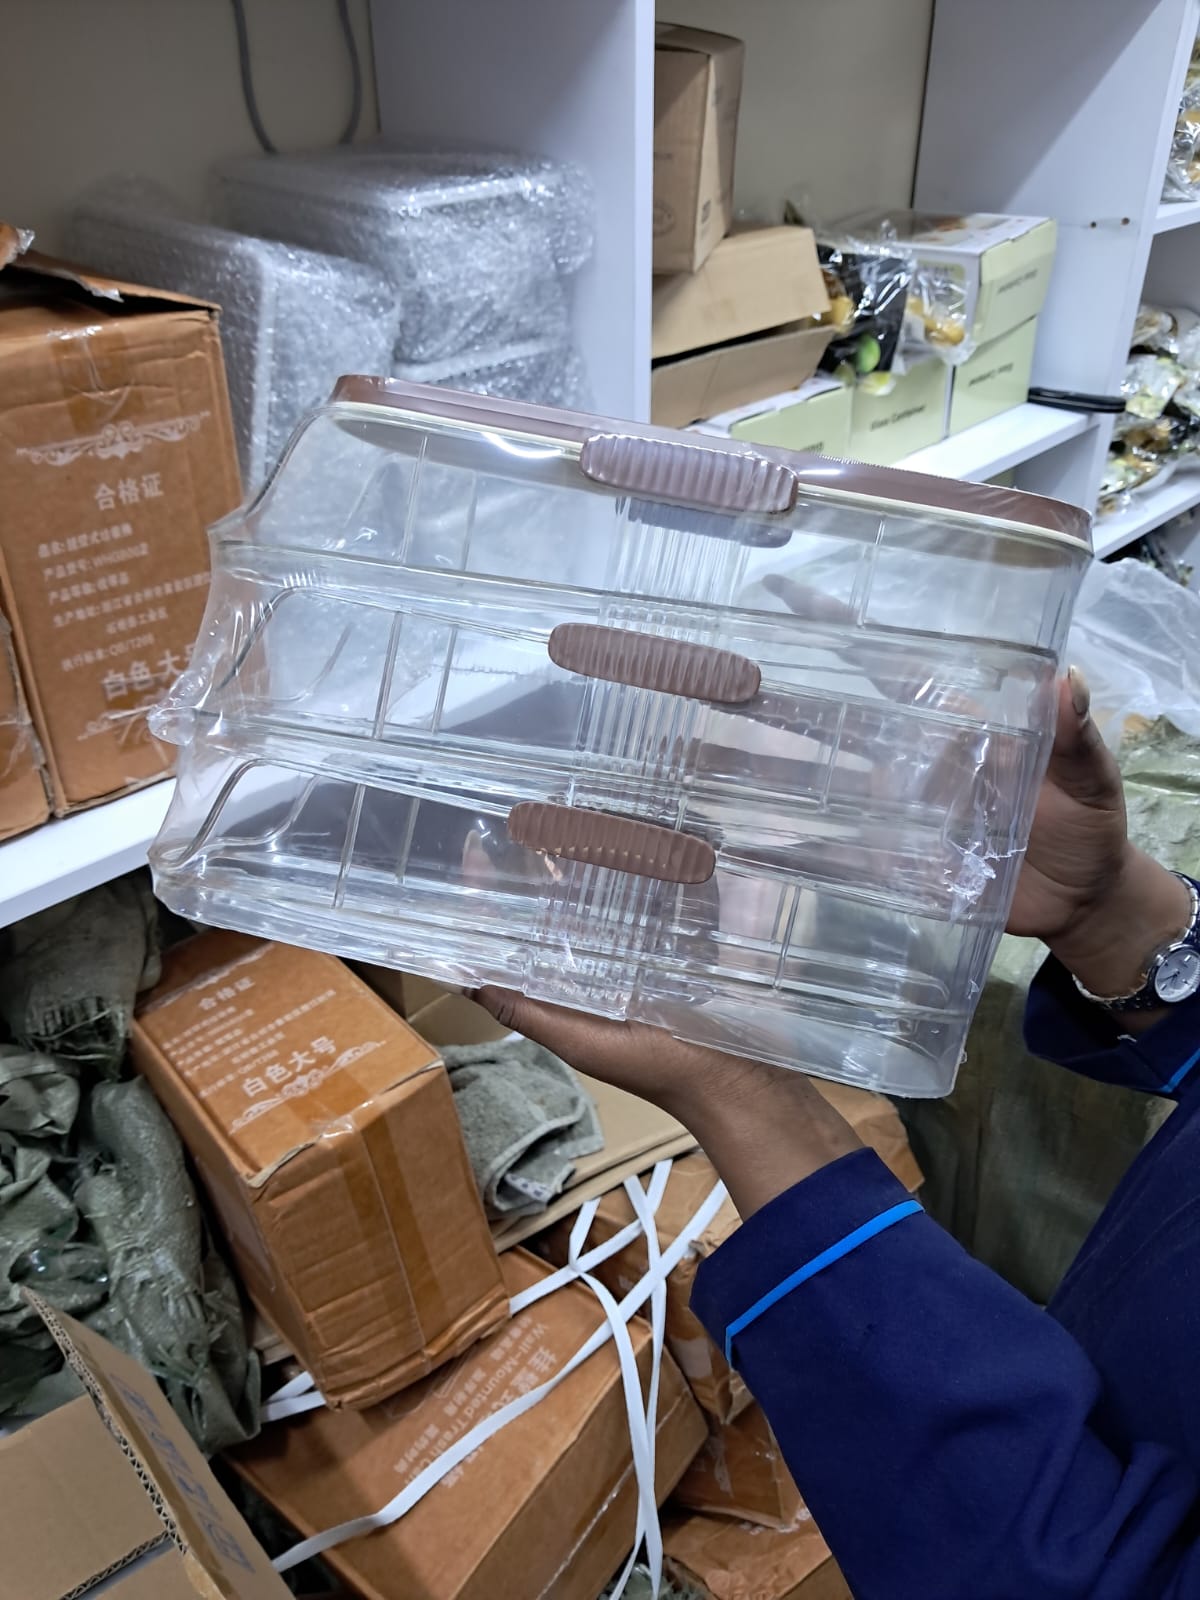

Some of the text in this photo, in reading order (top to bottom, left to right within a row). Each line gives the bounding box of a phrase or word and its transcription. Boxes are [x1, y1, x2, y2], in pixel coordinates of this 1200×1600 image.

[95, 472, 164, 511] 合格证
[199, 977, 255, 1011] 合格证
[242, 1035, 337, 1097] 白色大号
